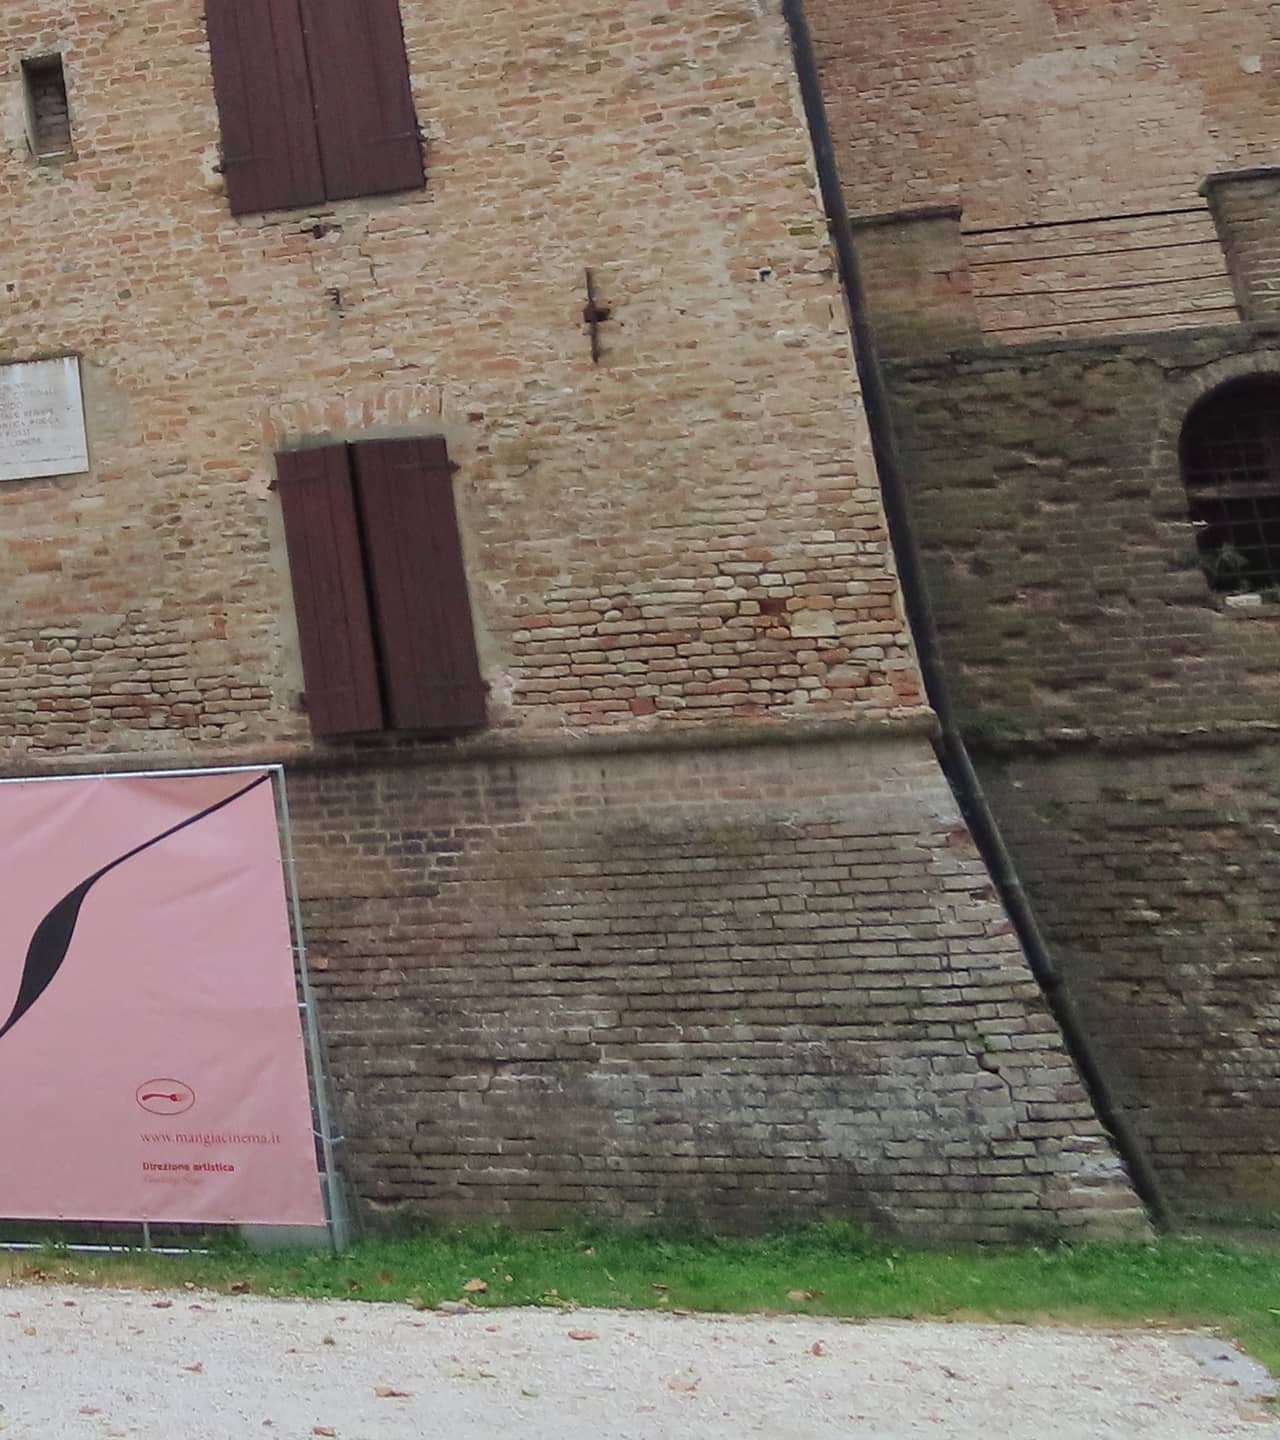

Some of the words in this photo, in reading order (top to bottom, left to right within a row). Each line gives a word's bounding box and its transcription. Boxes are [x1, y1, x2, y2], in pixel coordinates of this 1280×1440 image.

[140, 1132, 281, 1147] www.mangiacinema.it
[142, 1162, 190, 1171] Direzione
[193, 1163, 234, 1172] artistica
